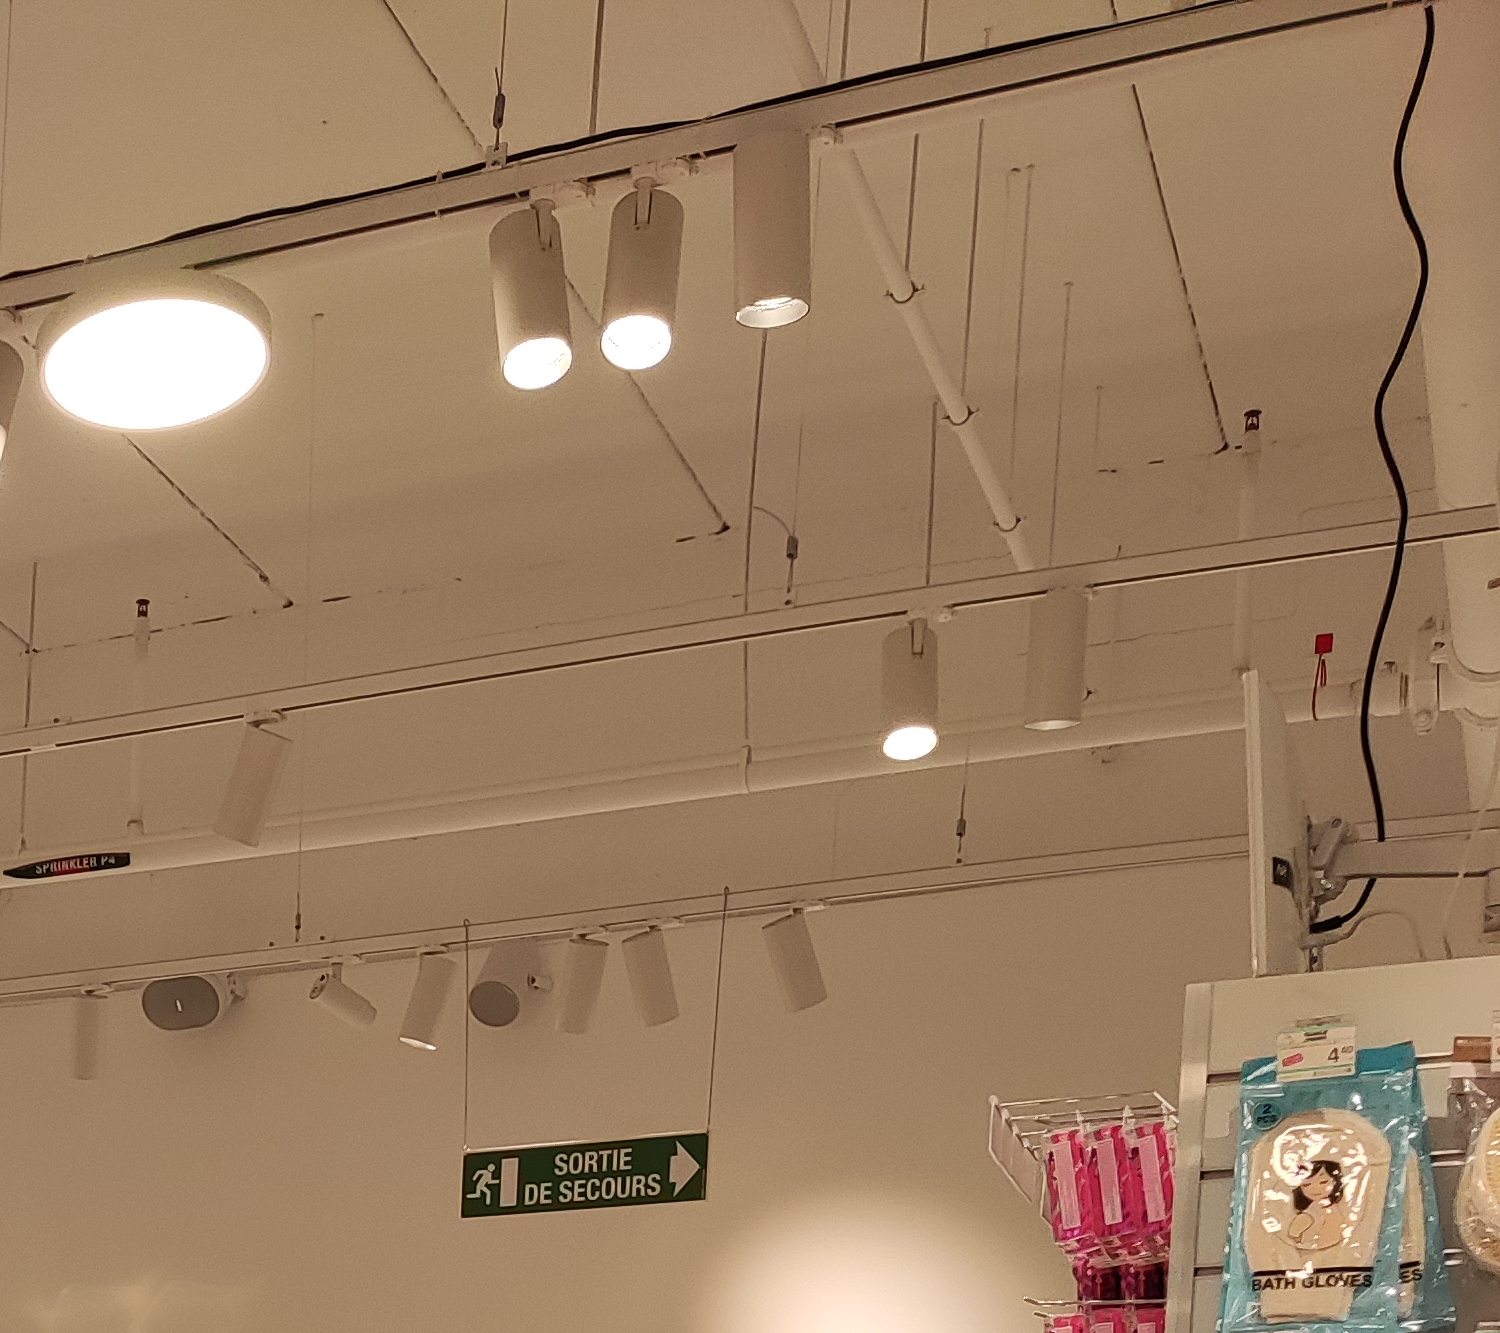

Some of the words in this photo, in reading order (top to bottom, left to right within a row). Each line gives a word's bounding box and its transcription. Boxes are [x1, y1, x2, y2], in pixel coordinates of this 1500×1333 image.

[35, 856, 98, 875] SPRINKLER
[101, 856, 116, 866] P4
[553, 1148, 633, 1177] SORTIE
[524, 1182, 553, 1207] DE
[558, 1173, 663, 1204] SECOURS
[1251, 1274, 1297, 1292] BATH
[1301, 1272, 1373, 1290] GLOVES
